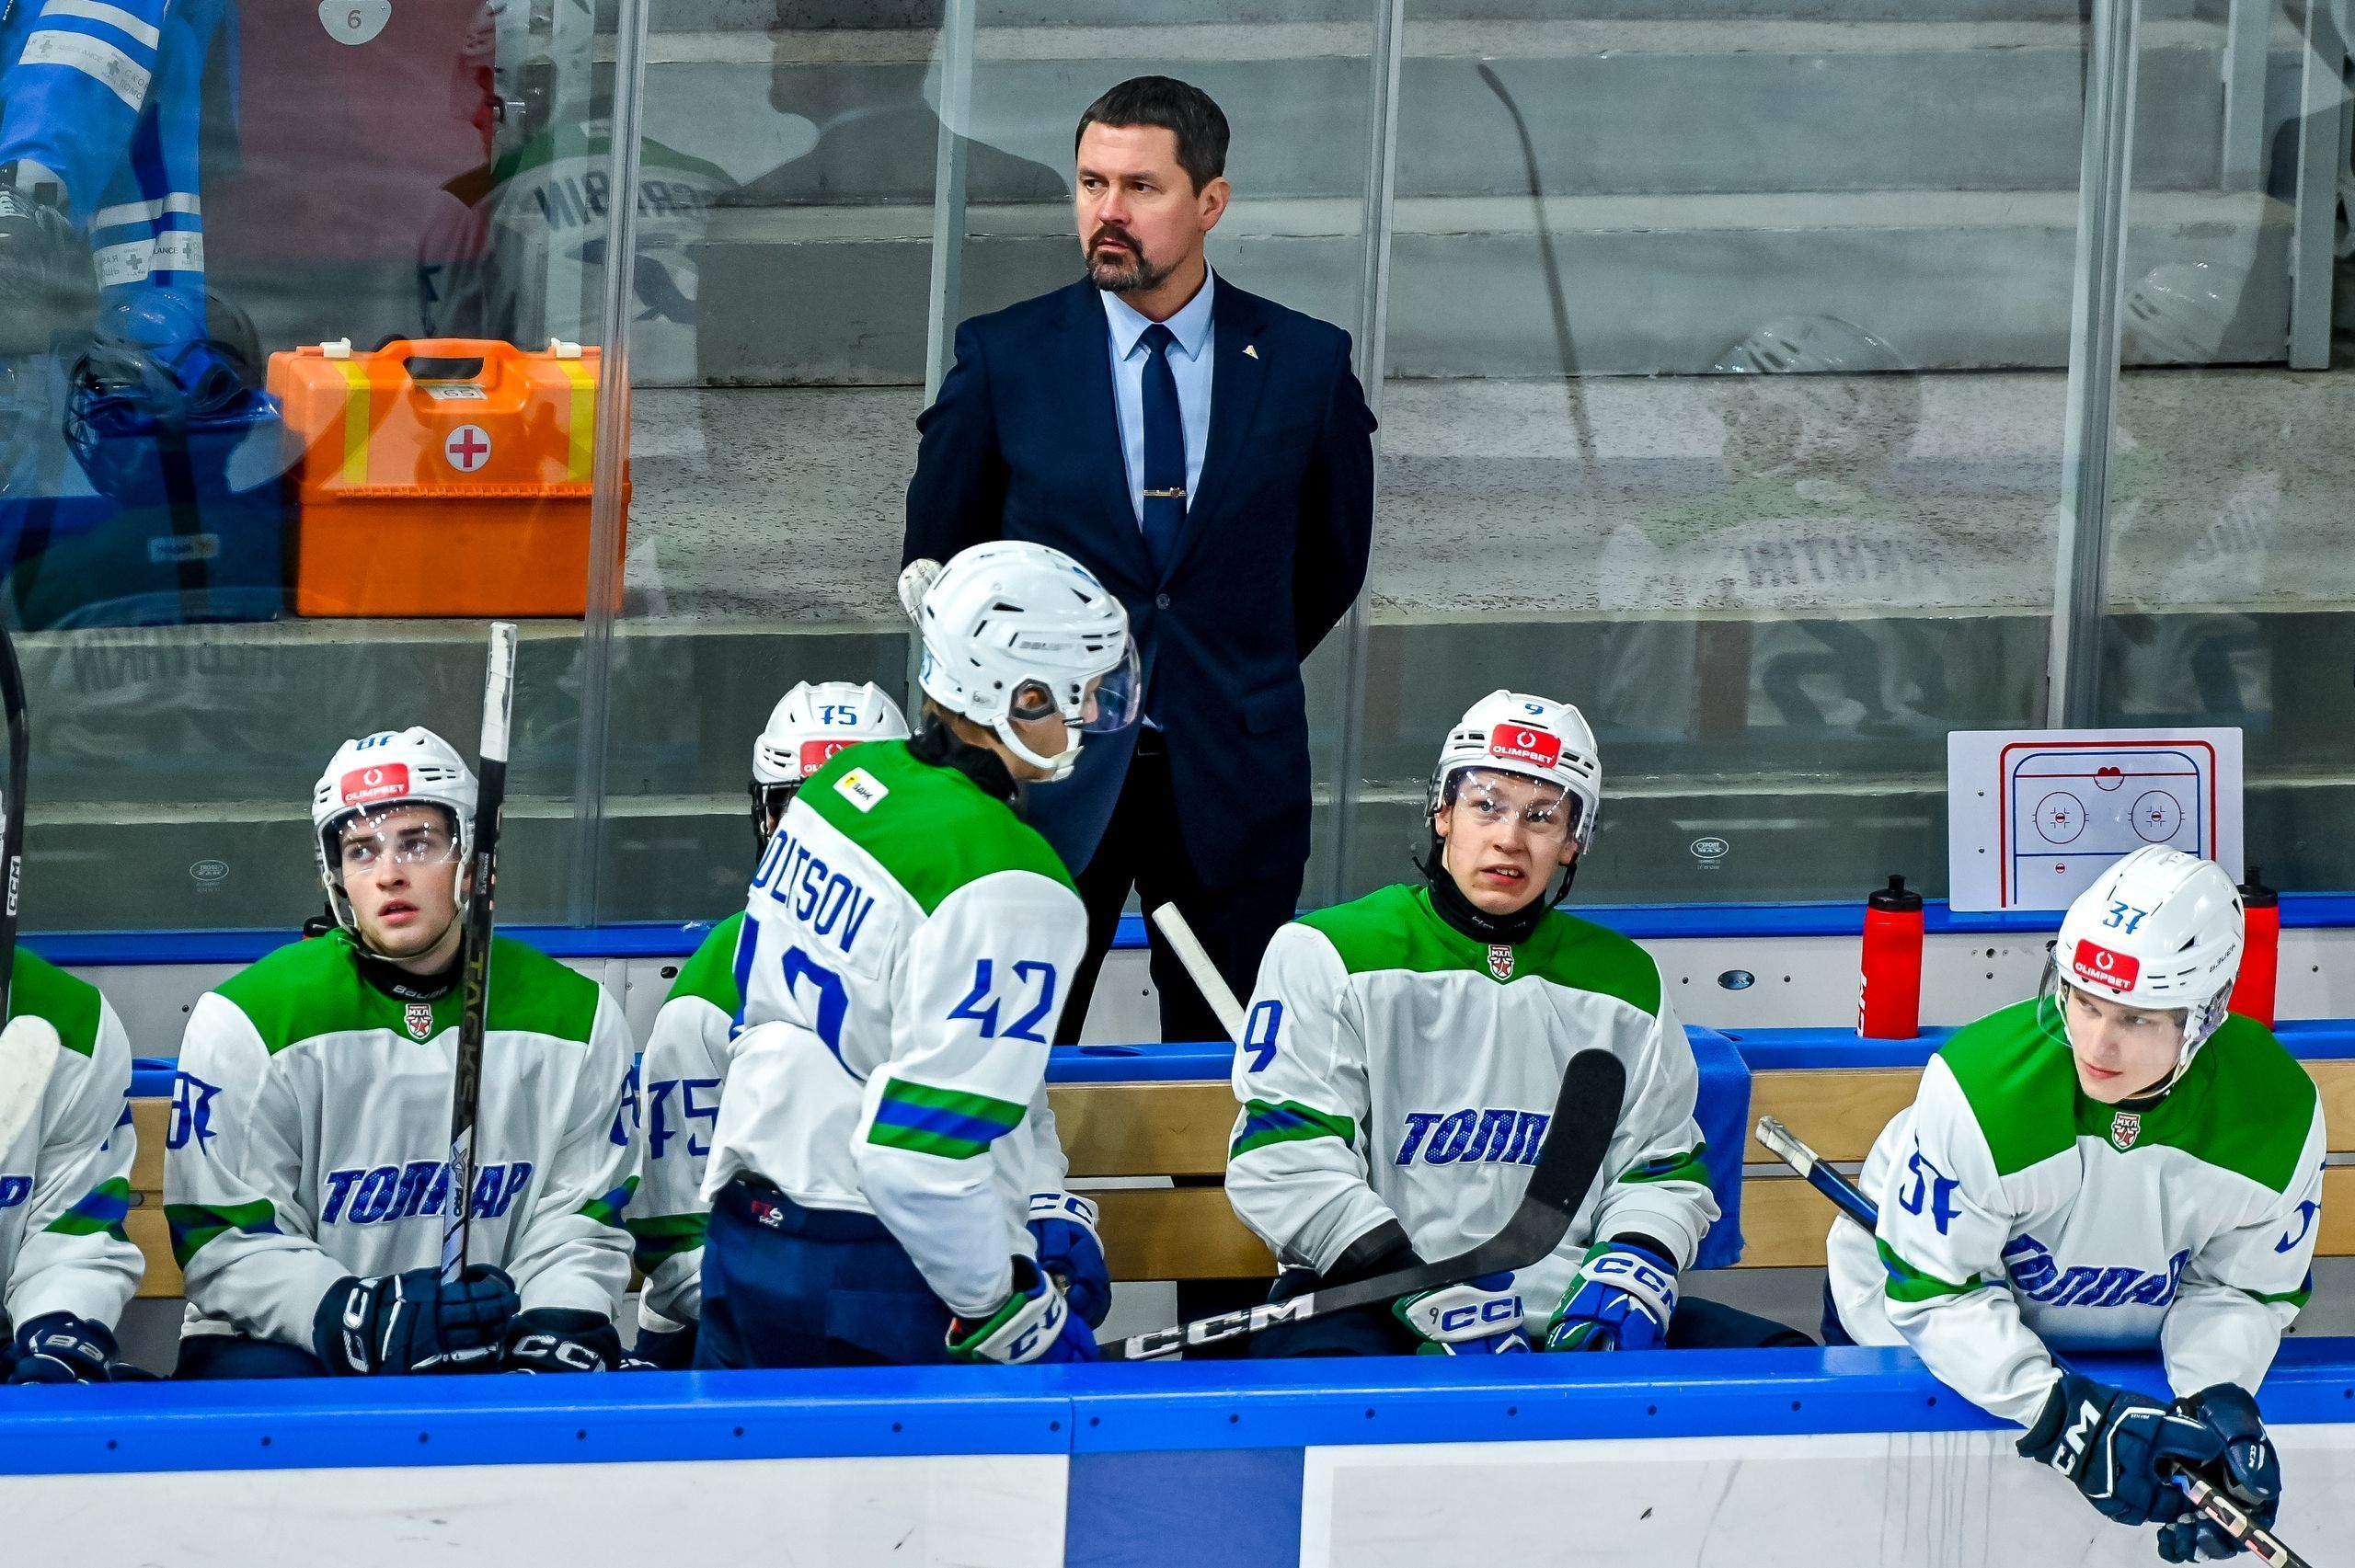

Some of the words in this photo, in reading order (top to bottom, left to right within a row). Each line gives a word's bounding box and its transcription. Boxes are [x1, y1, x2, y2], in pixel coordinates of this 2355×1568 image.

[348, 10, 361, 29] 6
[119, 79, 144, 100] ПОМО
[124, 69, 147, 89] СКО
[819, 704, 856, 726] 75
[1524, 703, 1544, 715] 9
[1492, 745, 1556, 764] OLIMPBET
[345, 783, 406, 801] OLIMPBET
[8, 860, 21, 911] CCM
[752, 829, 875, 954] OLTSOV
[2103, 899, 2148, 935] 37
[2074, 961, 2131, 989] OLIMPBET
[408, 1008, 430, 1016] МХЛ
[946, 958, 1057, 1044] 42
[1243, 1000, 1284, 1074] 9
[647, 1077, 722, 1161] 75
[2117, 1117, 2138, 1127] МХЛ
[1395, 1108, 1553, 1167] ТОЛП
[1028, 1193, 1093, 1226] CC
[1008, 1293, 1063, 1360] CC
[1124, 1292, 1315, 1359] CCM
[1429, 1307, 1441, 1325] 9
[512, 1334, 607, 1374] CC
[2051, 1399, 2101, 1477] CM
